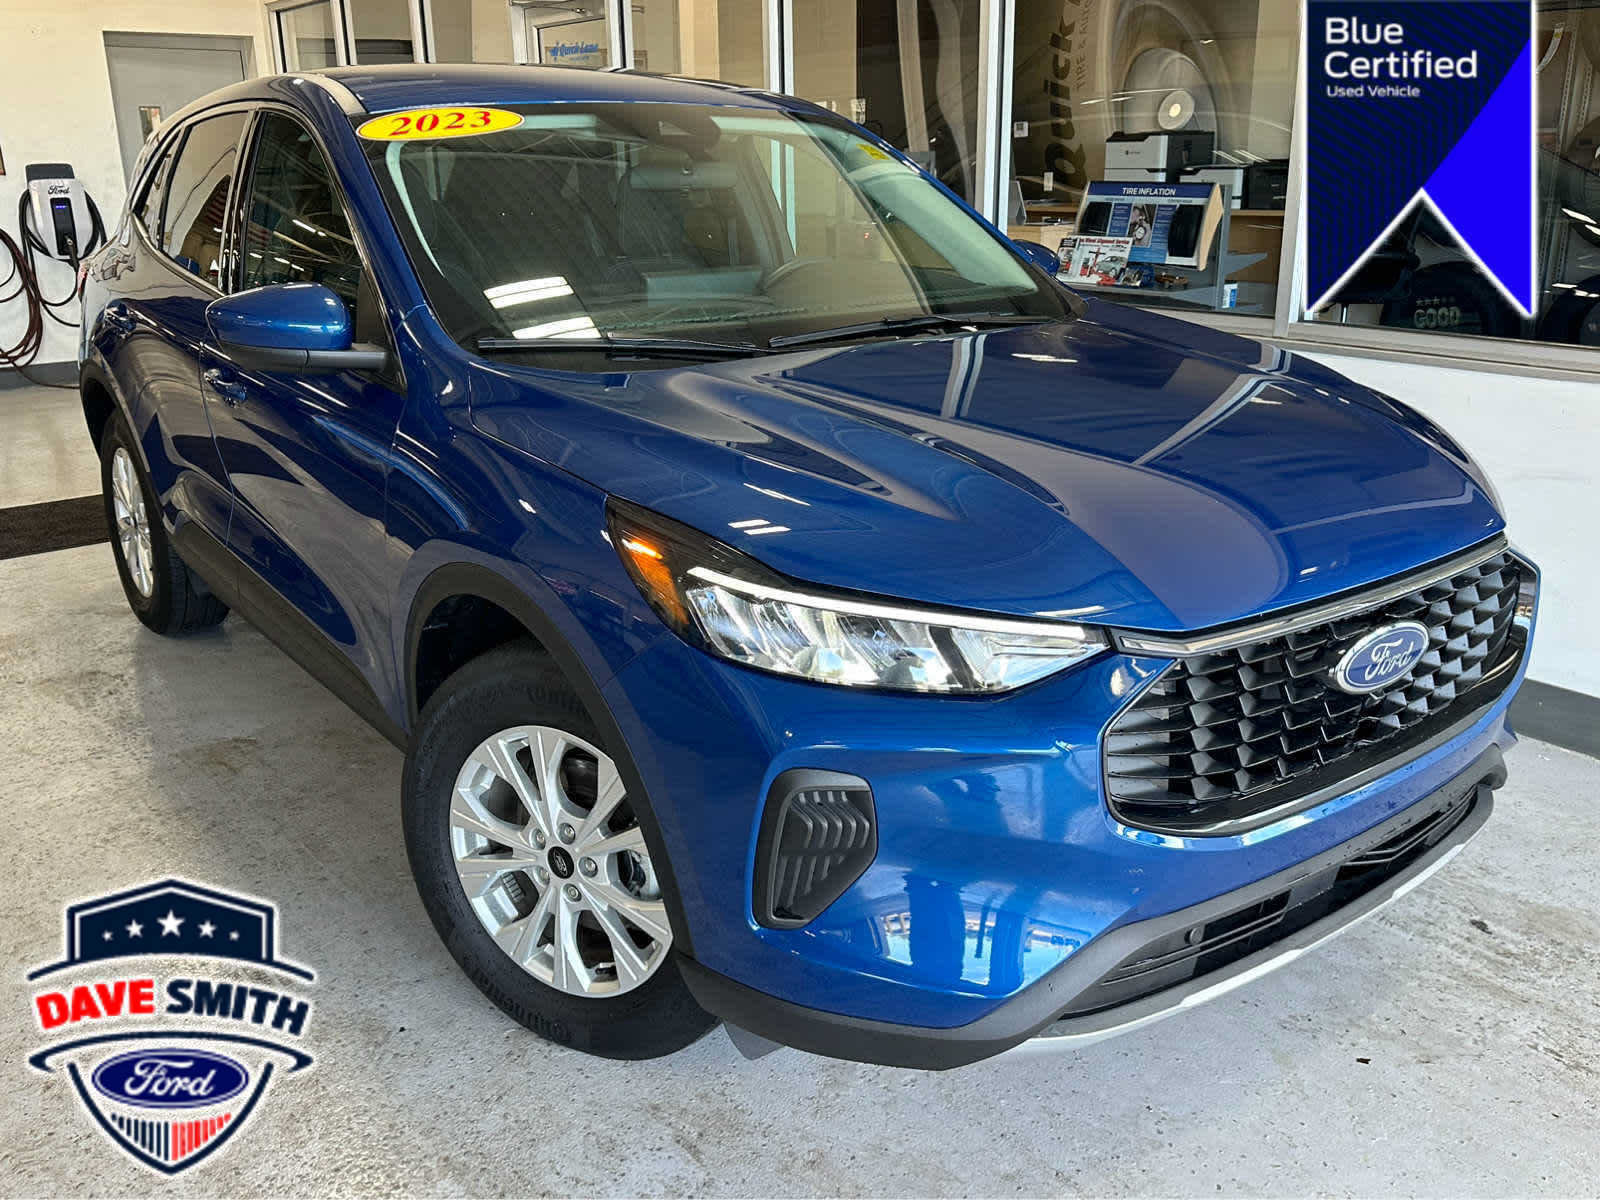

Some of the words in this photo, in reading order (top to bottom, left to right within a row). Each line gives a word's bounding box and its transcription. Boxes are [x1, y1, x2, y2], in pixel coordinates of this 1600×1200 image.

[388, 111, 491, 137] 2023
[47, 185, 70, 195] Ford
[1122, 187, 1138, 195] TIRE
[1138, 187, 1177, 196] INFLATION
[1365, 638, 1414, 681] Ford
